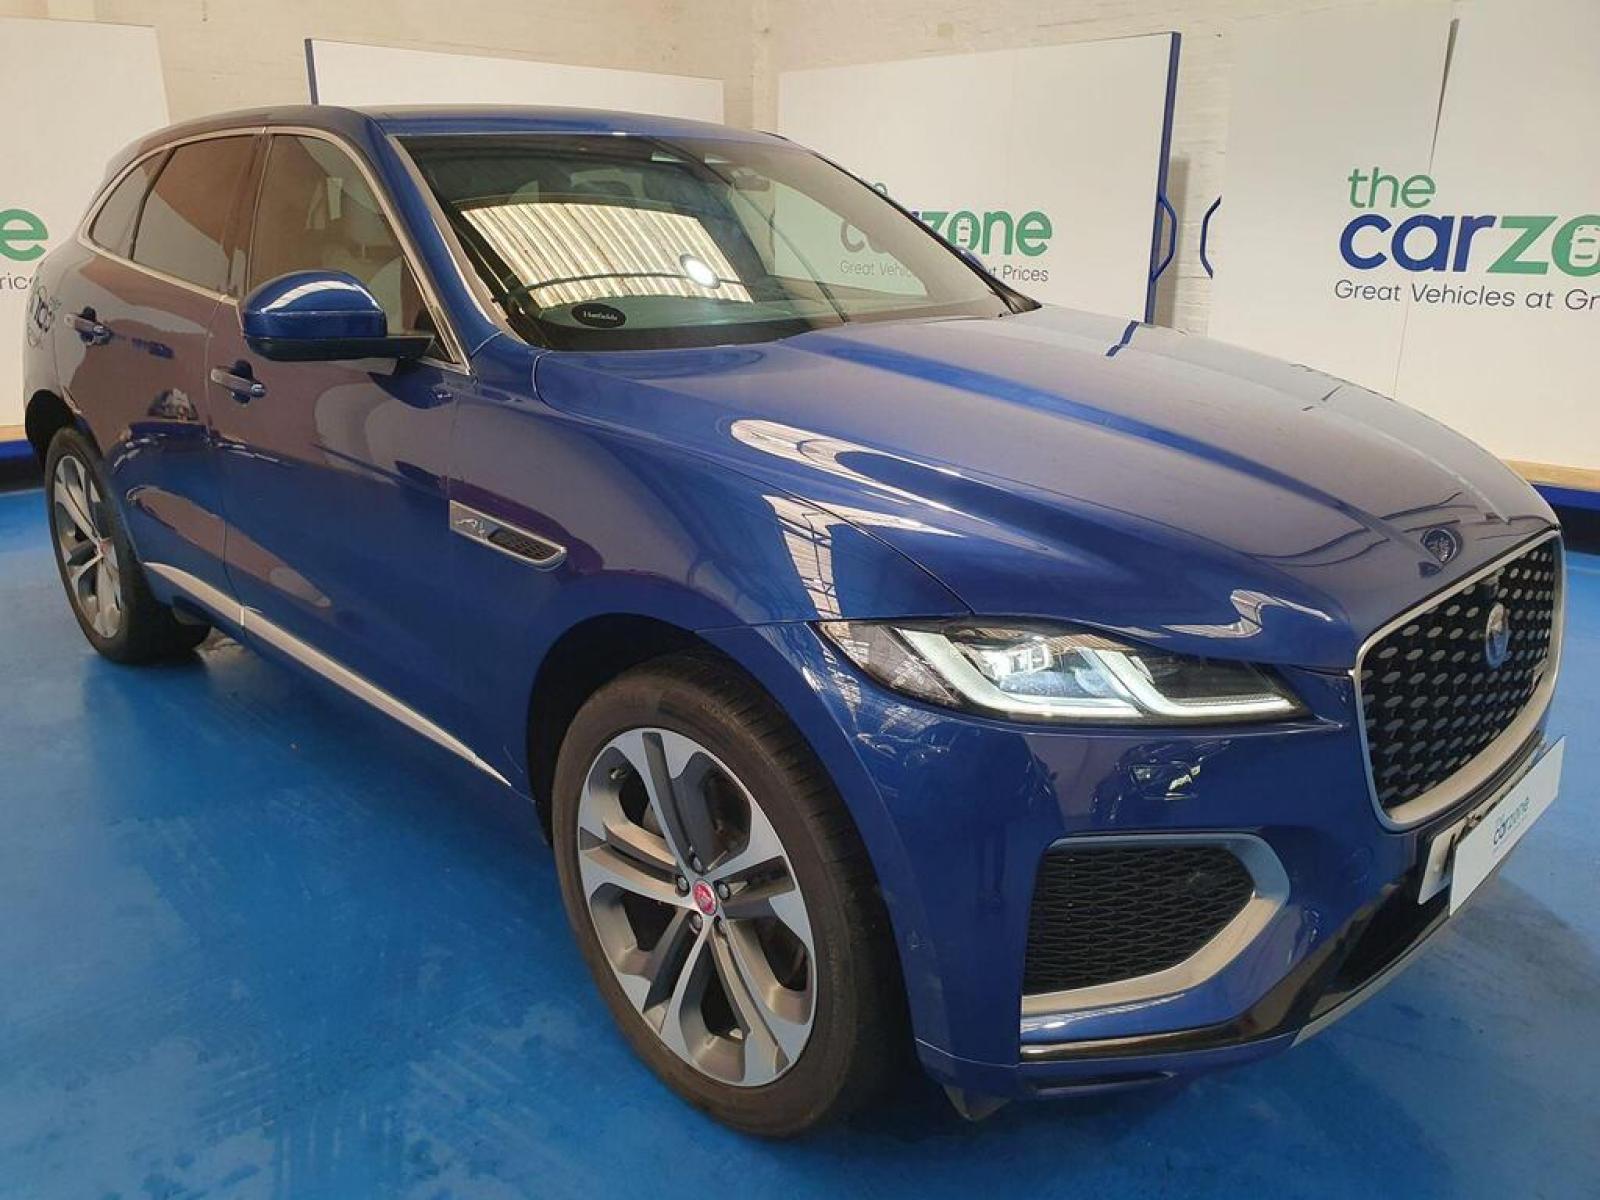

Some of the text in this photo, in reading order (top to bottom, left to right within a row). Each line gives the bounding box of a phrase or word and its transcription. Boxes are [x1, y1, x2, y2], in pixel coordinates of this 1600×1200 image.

[1348, 167, 1436, 208] the
[1002, 265, 1049, 281] Prices
[1335, 279, 1401, 301] Great
[1411, 283, 1515, 307] Vehicles
[1525, 292, 1553, 309] at
